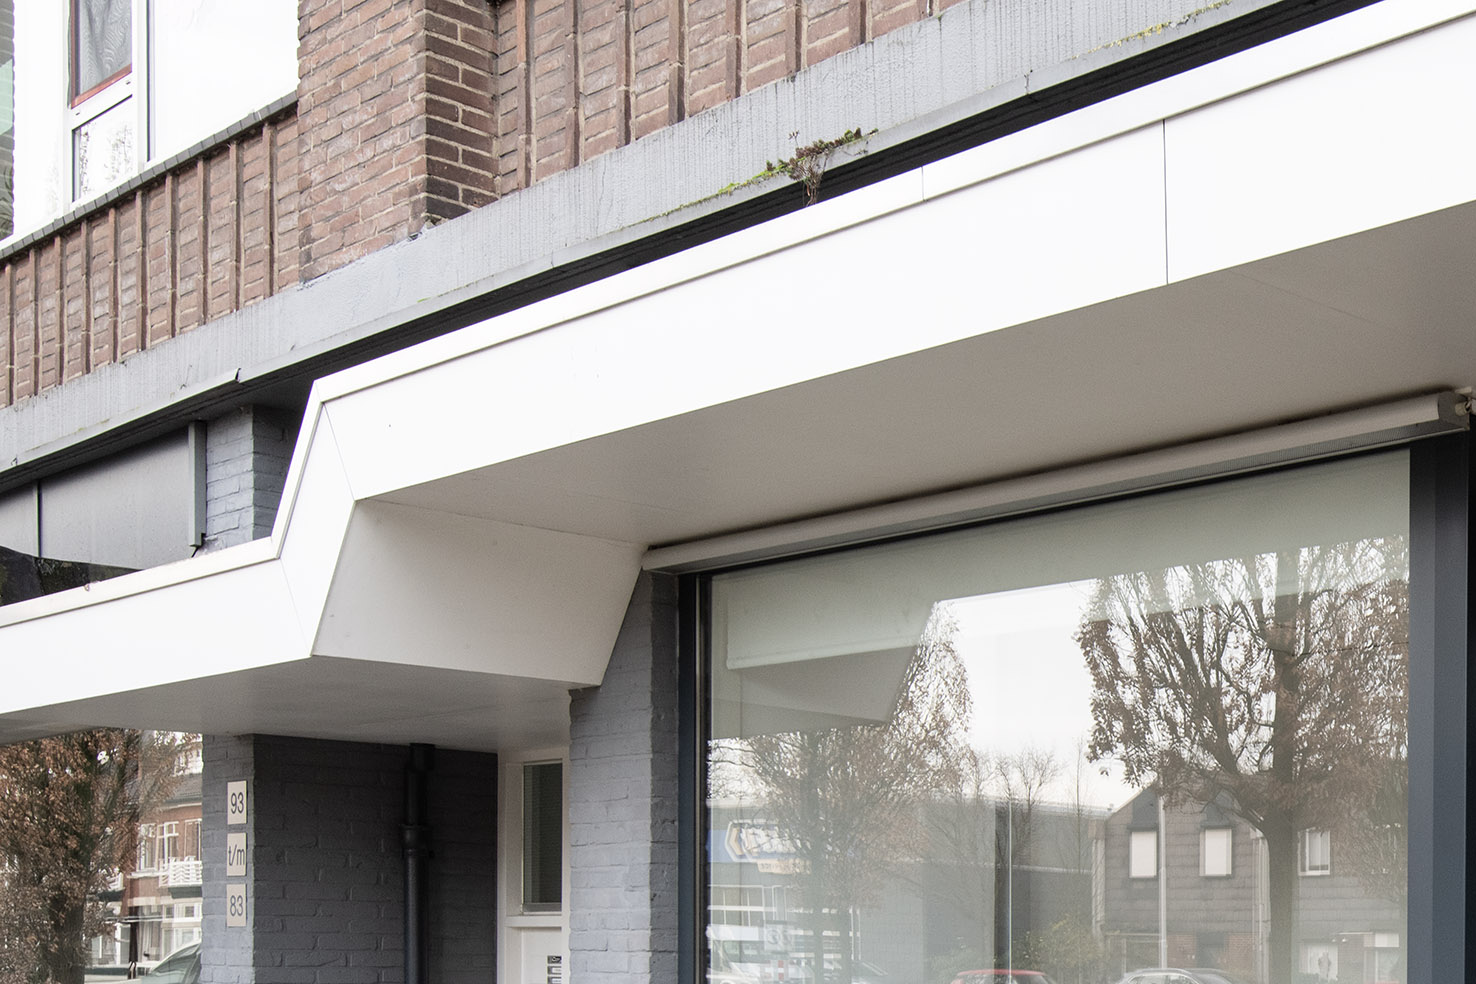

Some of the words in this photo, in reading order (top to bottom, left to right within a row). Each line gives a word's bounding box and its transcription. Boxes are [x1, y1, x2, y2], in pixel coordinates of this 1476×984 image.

[230, 792, 244, 814] 93
[228, 845, 245, 866] t/m
[229, 895, 243, 916] 83
